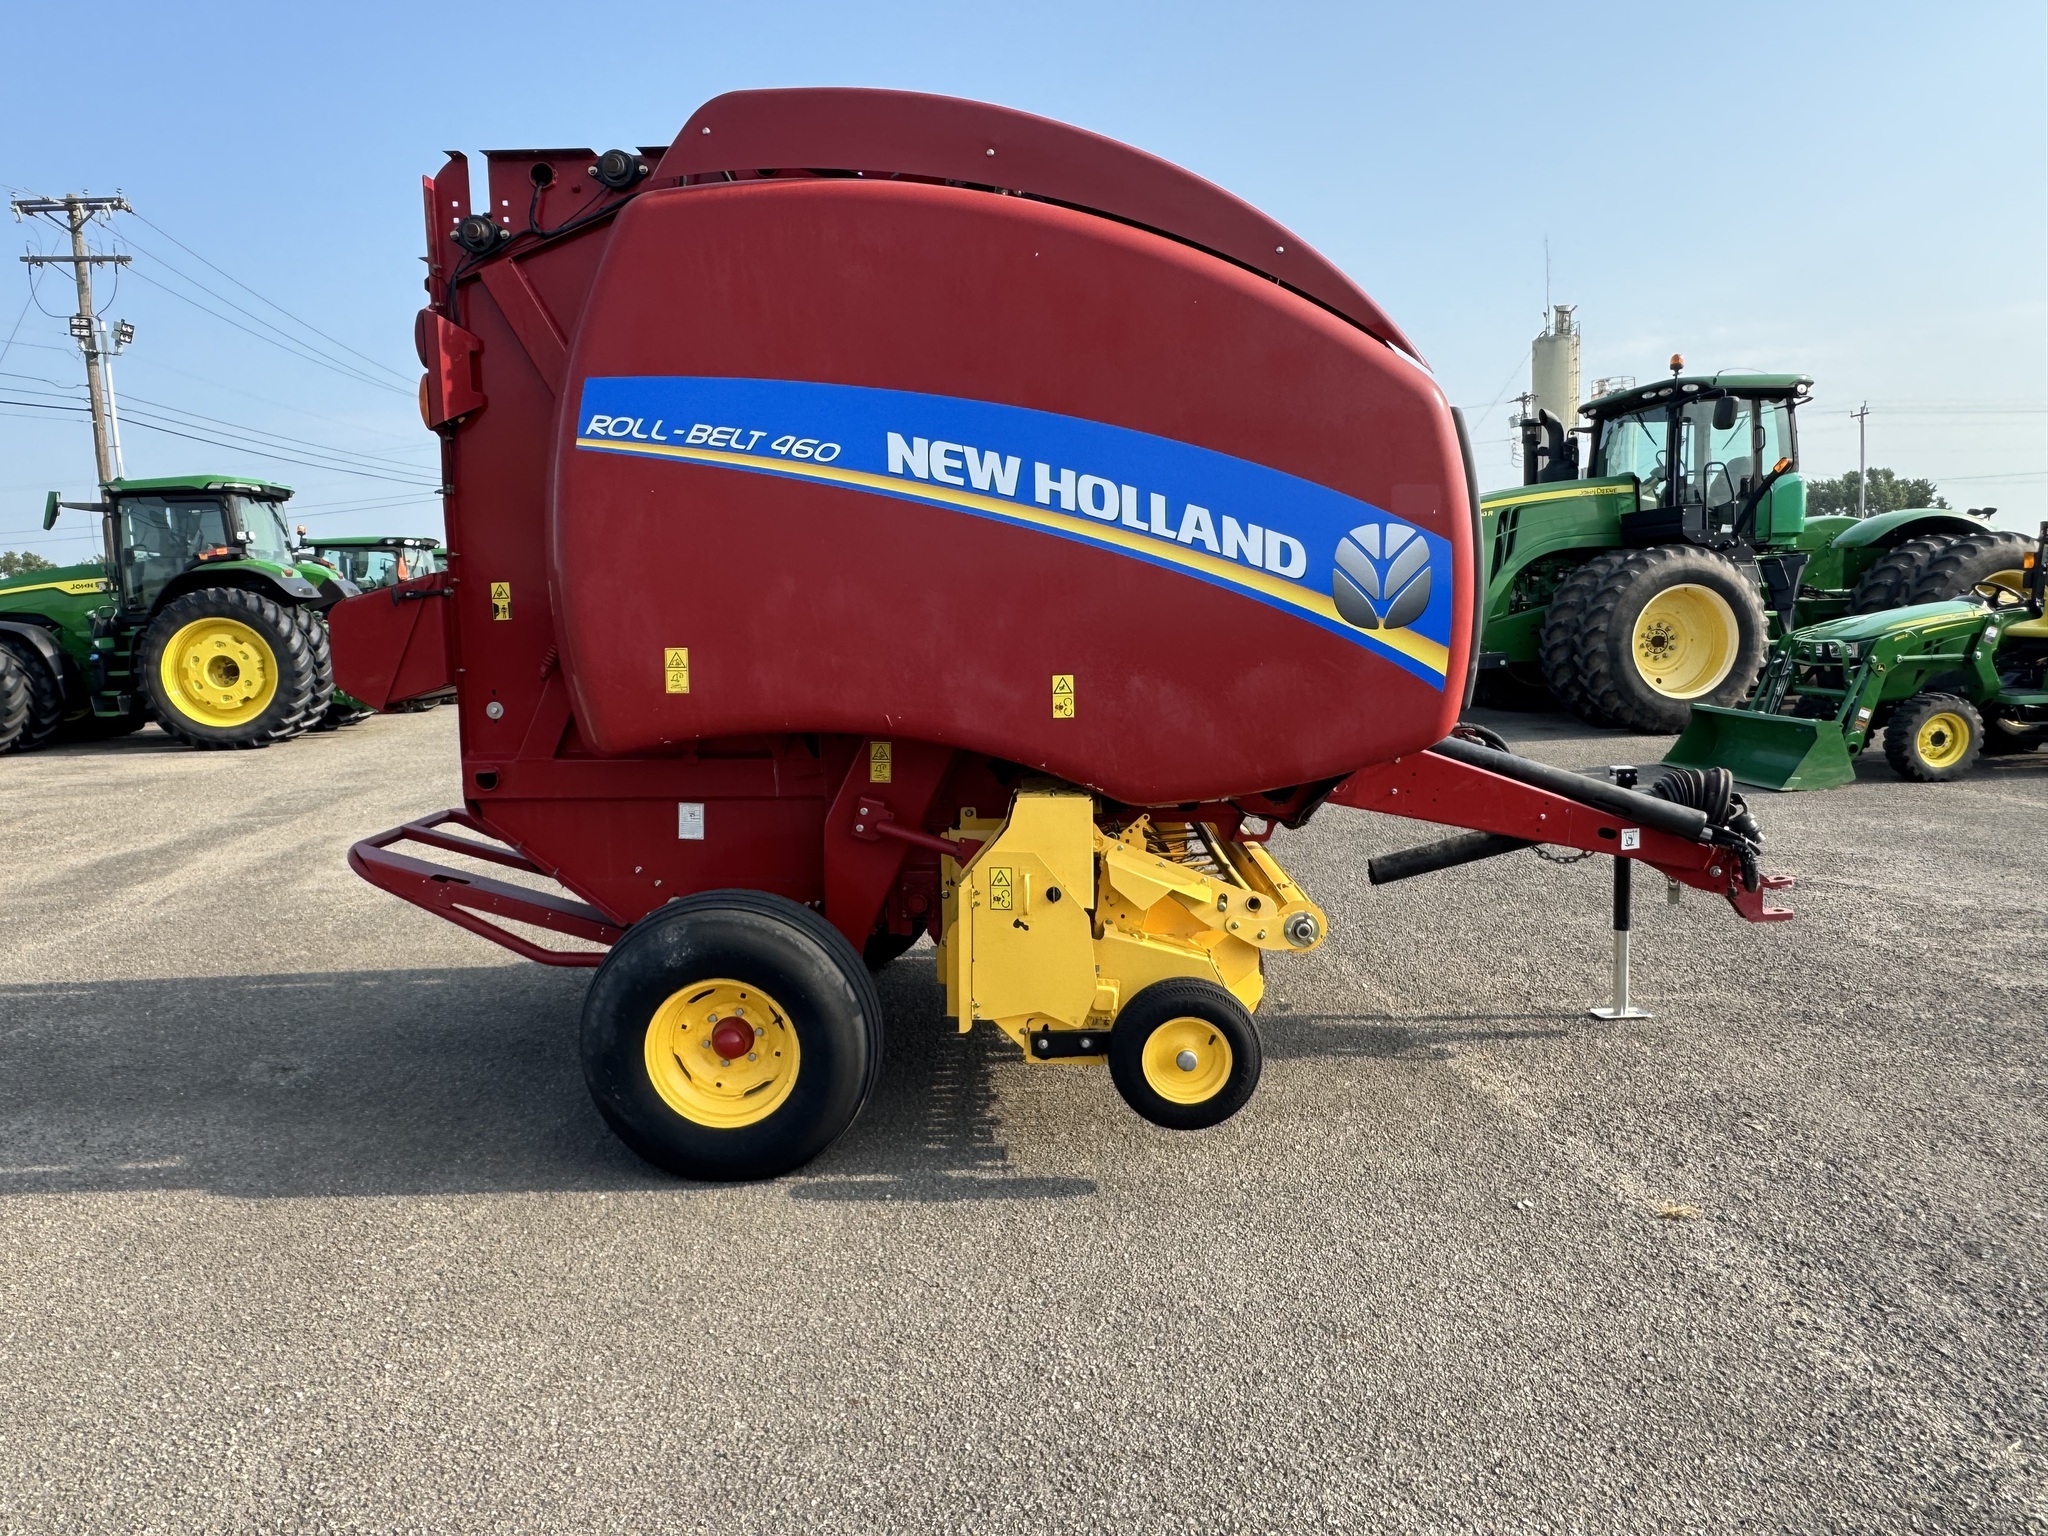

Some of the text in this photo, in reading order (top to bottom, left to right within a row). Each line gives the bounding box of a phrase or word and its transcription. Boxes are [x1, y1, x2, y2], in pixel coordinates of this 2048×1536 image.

[585, 414, 842, 463] ROLL-BELT 460
[886, 431, 1308, 579] NEW HOLLAND
